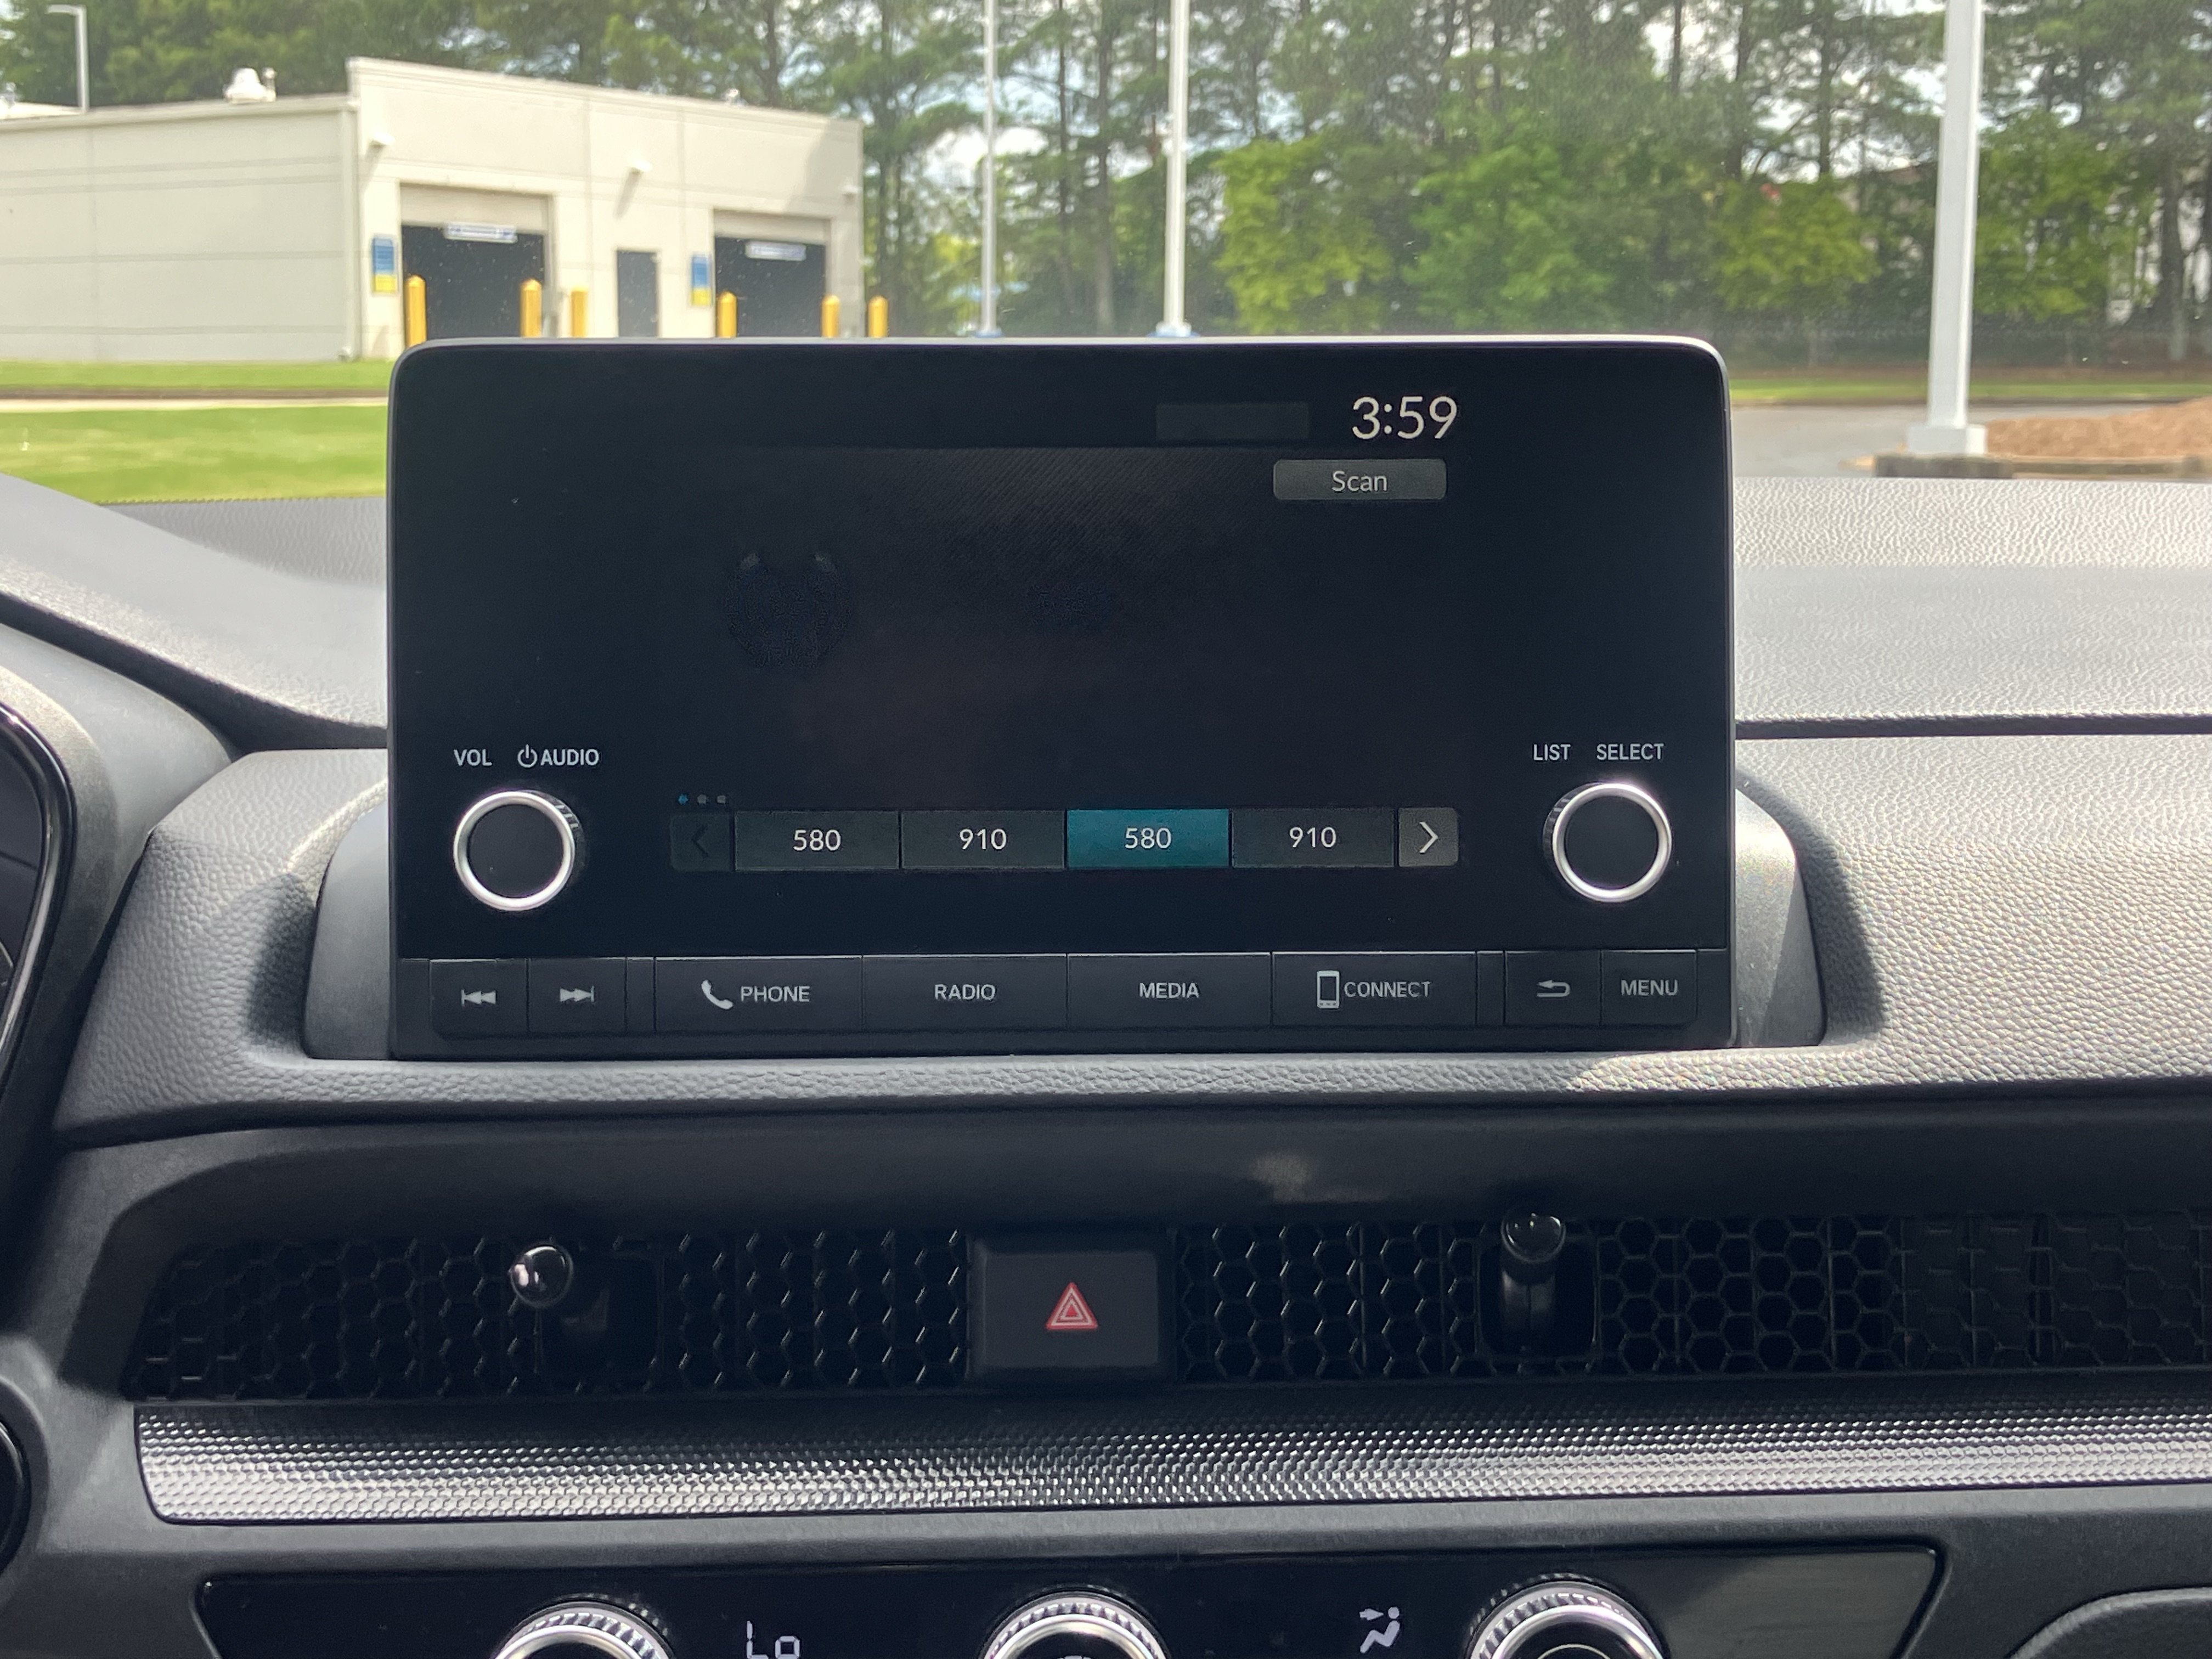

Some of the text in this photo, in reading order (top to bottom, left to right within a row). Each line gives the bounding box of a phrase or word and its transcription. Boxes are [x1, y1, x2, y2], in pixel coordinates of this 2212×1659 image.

[1352, 396, 1457, 439] 3:59
[1331, 470, 1387, 492] Scan
[453, 748, 599, 766] VOL AUDIO
[1533, 743, 1664, 761] LIST SELECT
[793, 829, 841, 851] 580
[960, 828, 1007, 850] 910
[1125, 827, 1171, 849] 580
[1289, 827, 1336, 848] 910
[741, 985, 810, 1002] PHONE
[934, 984, 996, 1001] RADIO
[1139, 983, 1199, 998] MEDIA
[1344, 981, 1430, 998] CONNECT
[1621, 979, 1678, 996] MENU
[746, 1621, 800, 1659] Lo
